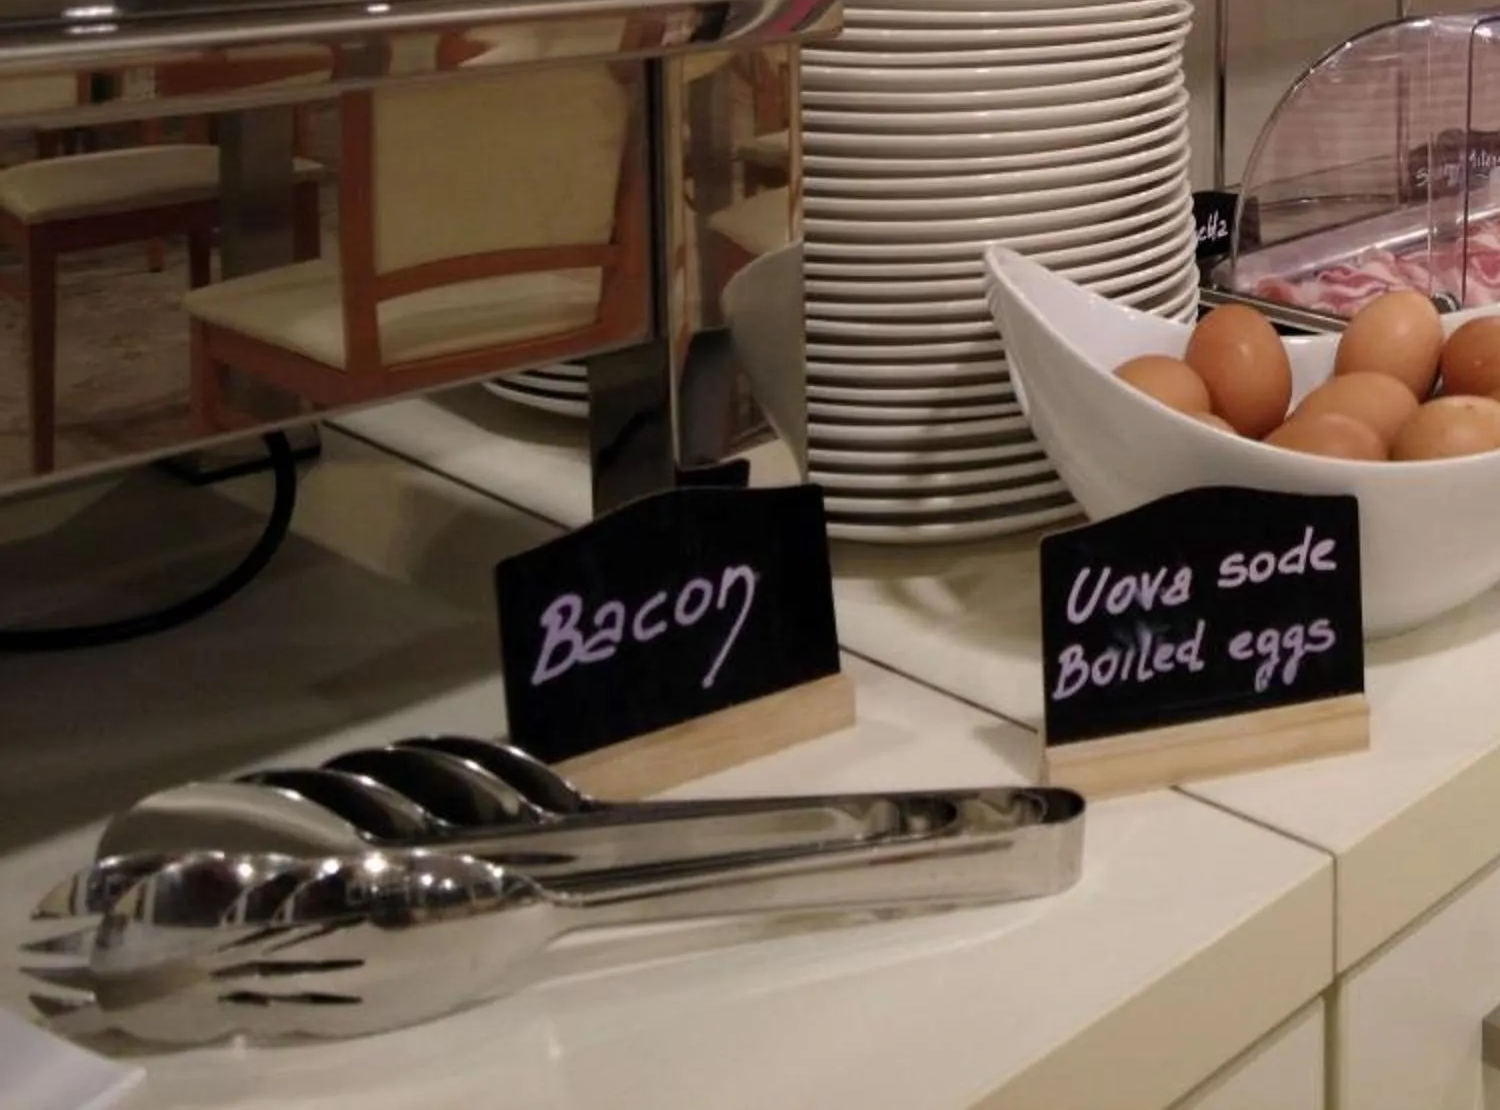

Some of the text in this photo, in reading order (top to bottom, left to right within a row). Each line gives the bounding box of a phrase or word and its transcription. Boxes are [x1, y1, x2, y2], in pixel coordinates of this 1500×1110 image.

[532, 563, 755, 687] Bacon
[1067, 527, 1337, 626] Uova sode
[1053, 619, 1335, 700] Boiled eggs
